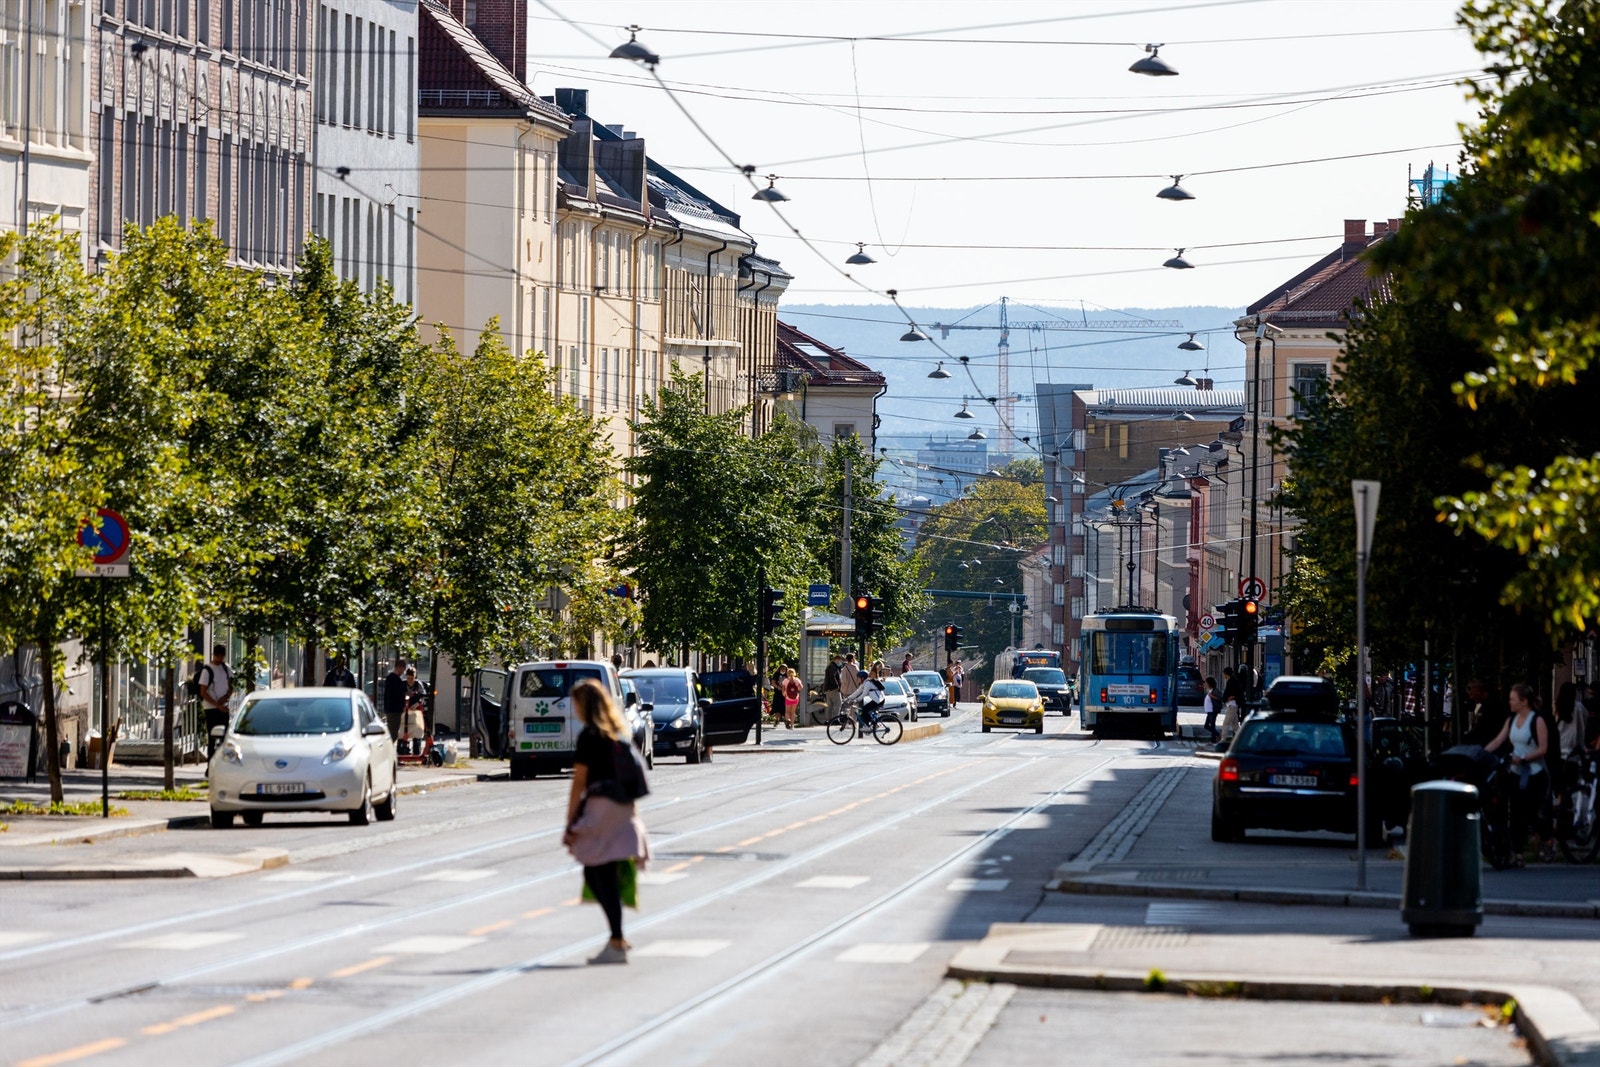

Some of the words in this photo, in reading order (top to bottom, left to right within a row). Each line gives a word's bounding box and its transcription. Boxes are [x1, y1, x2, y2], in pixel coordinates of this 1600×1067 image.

[1244, 583, 1262, 597] 40
[1202, 618, 1212, 626] 40
[1123, 695, 1135, 705] 101
